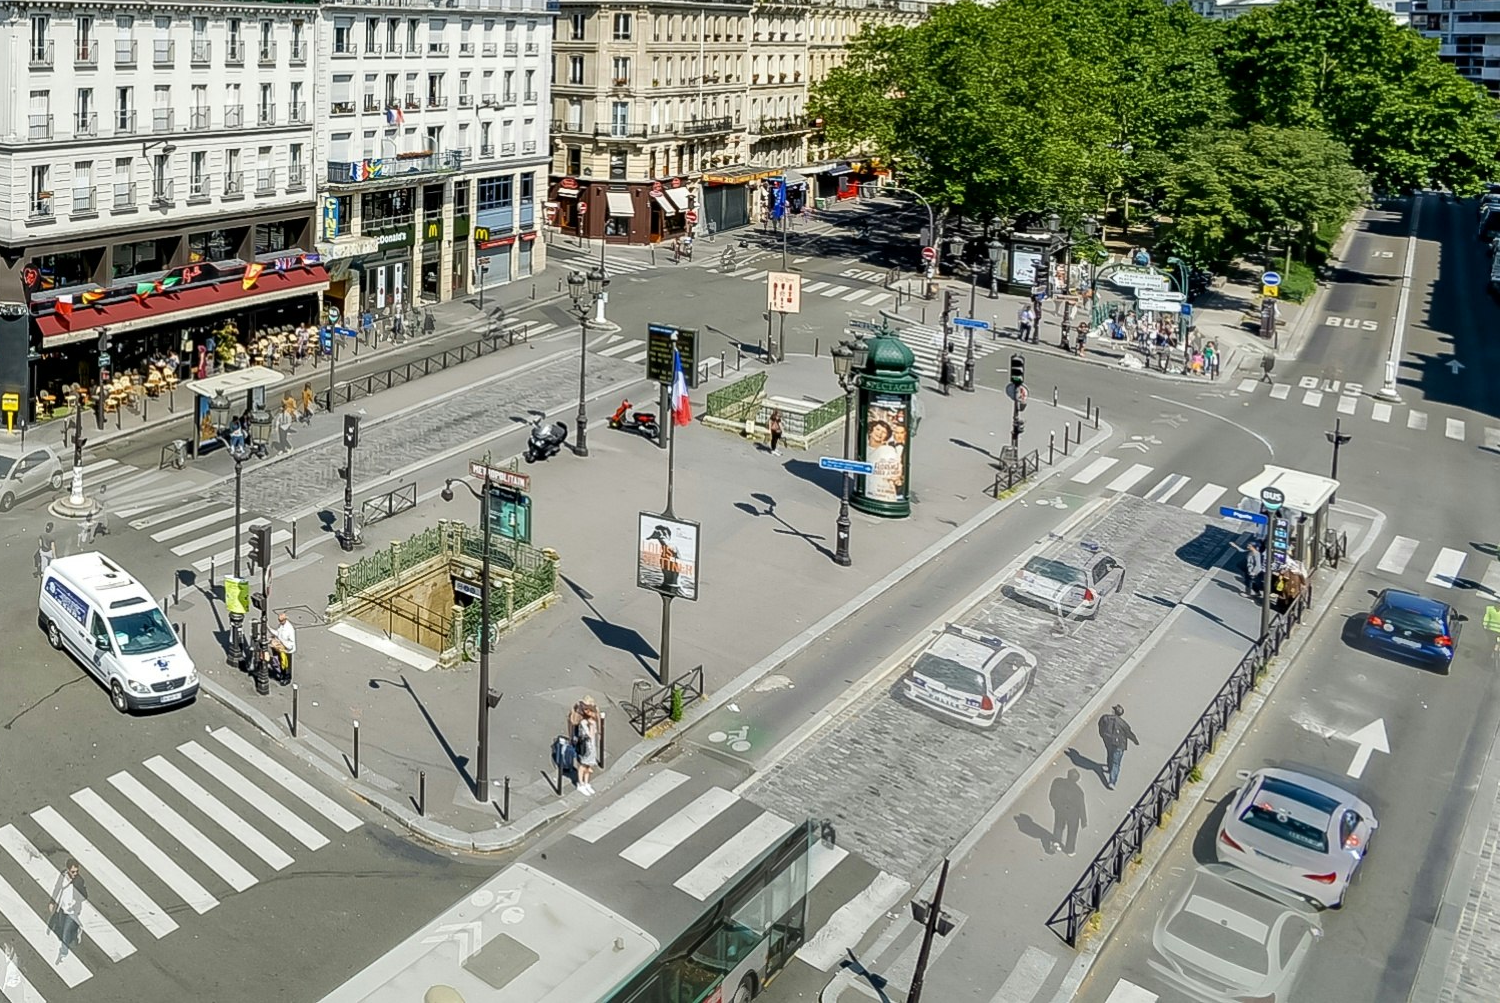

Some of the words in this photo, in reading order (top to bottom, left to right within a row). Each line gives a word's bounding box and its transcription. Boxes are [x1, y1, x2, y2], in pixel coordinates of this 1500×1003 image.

[373, 230, 407, 245] cDonald's
[1325, 316, 1379, 331] BUS
[1298, 375, 1364, 396] BUS
[1262, 490, 1282, 502] BUS
